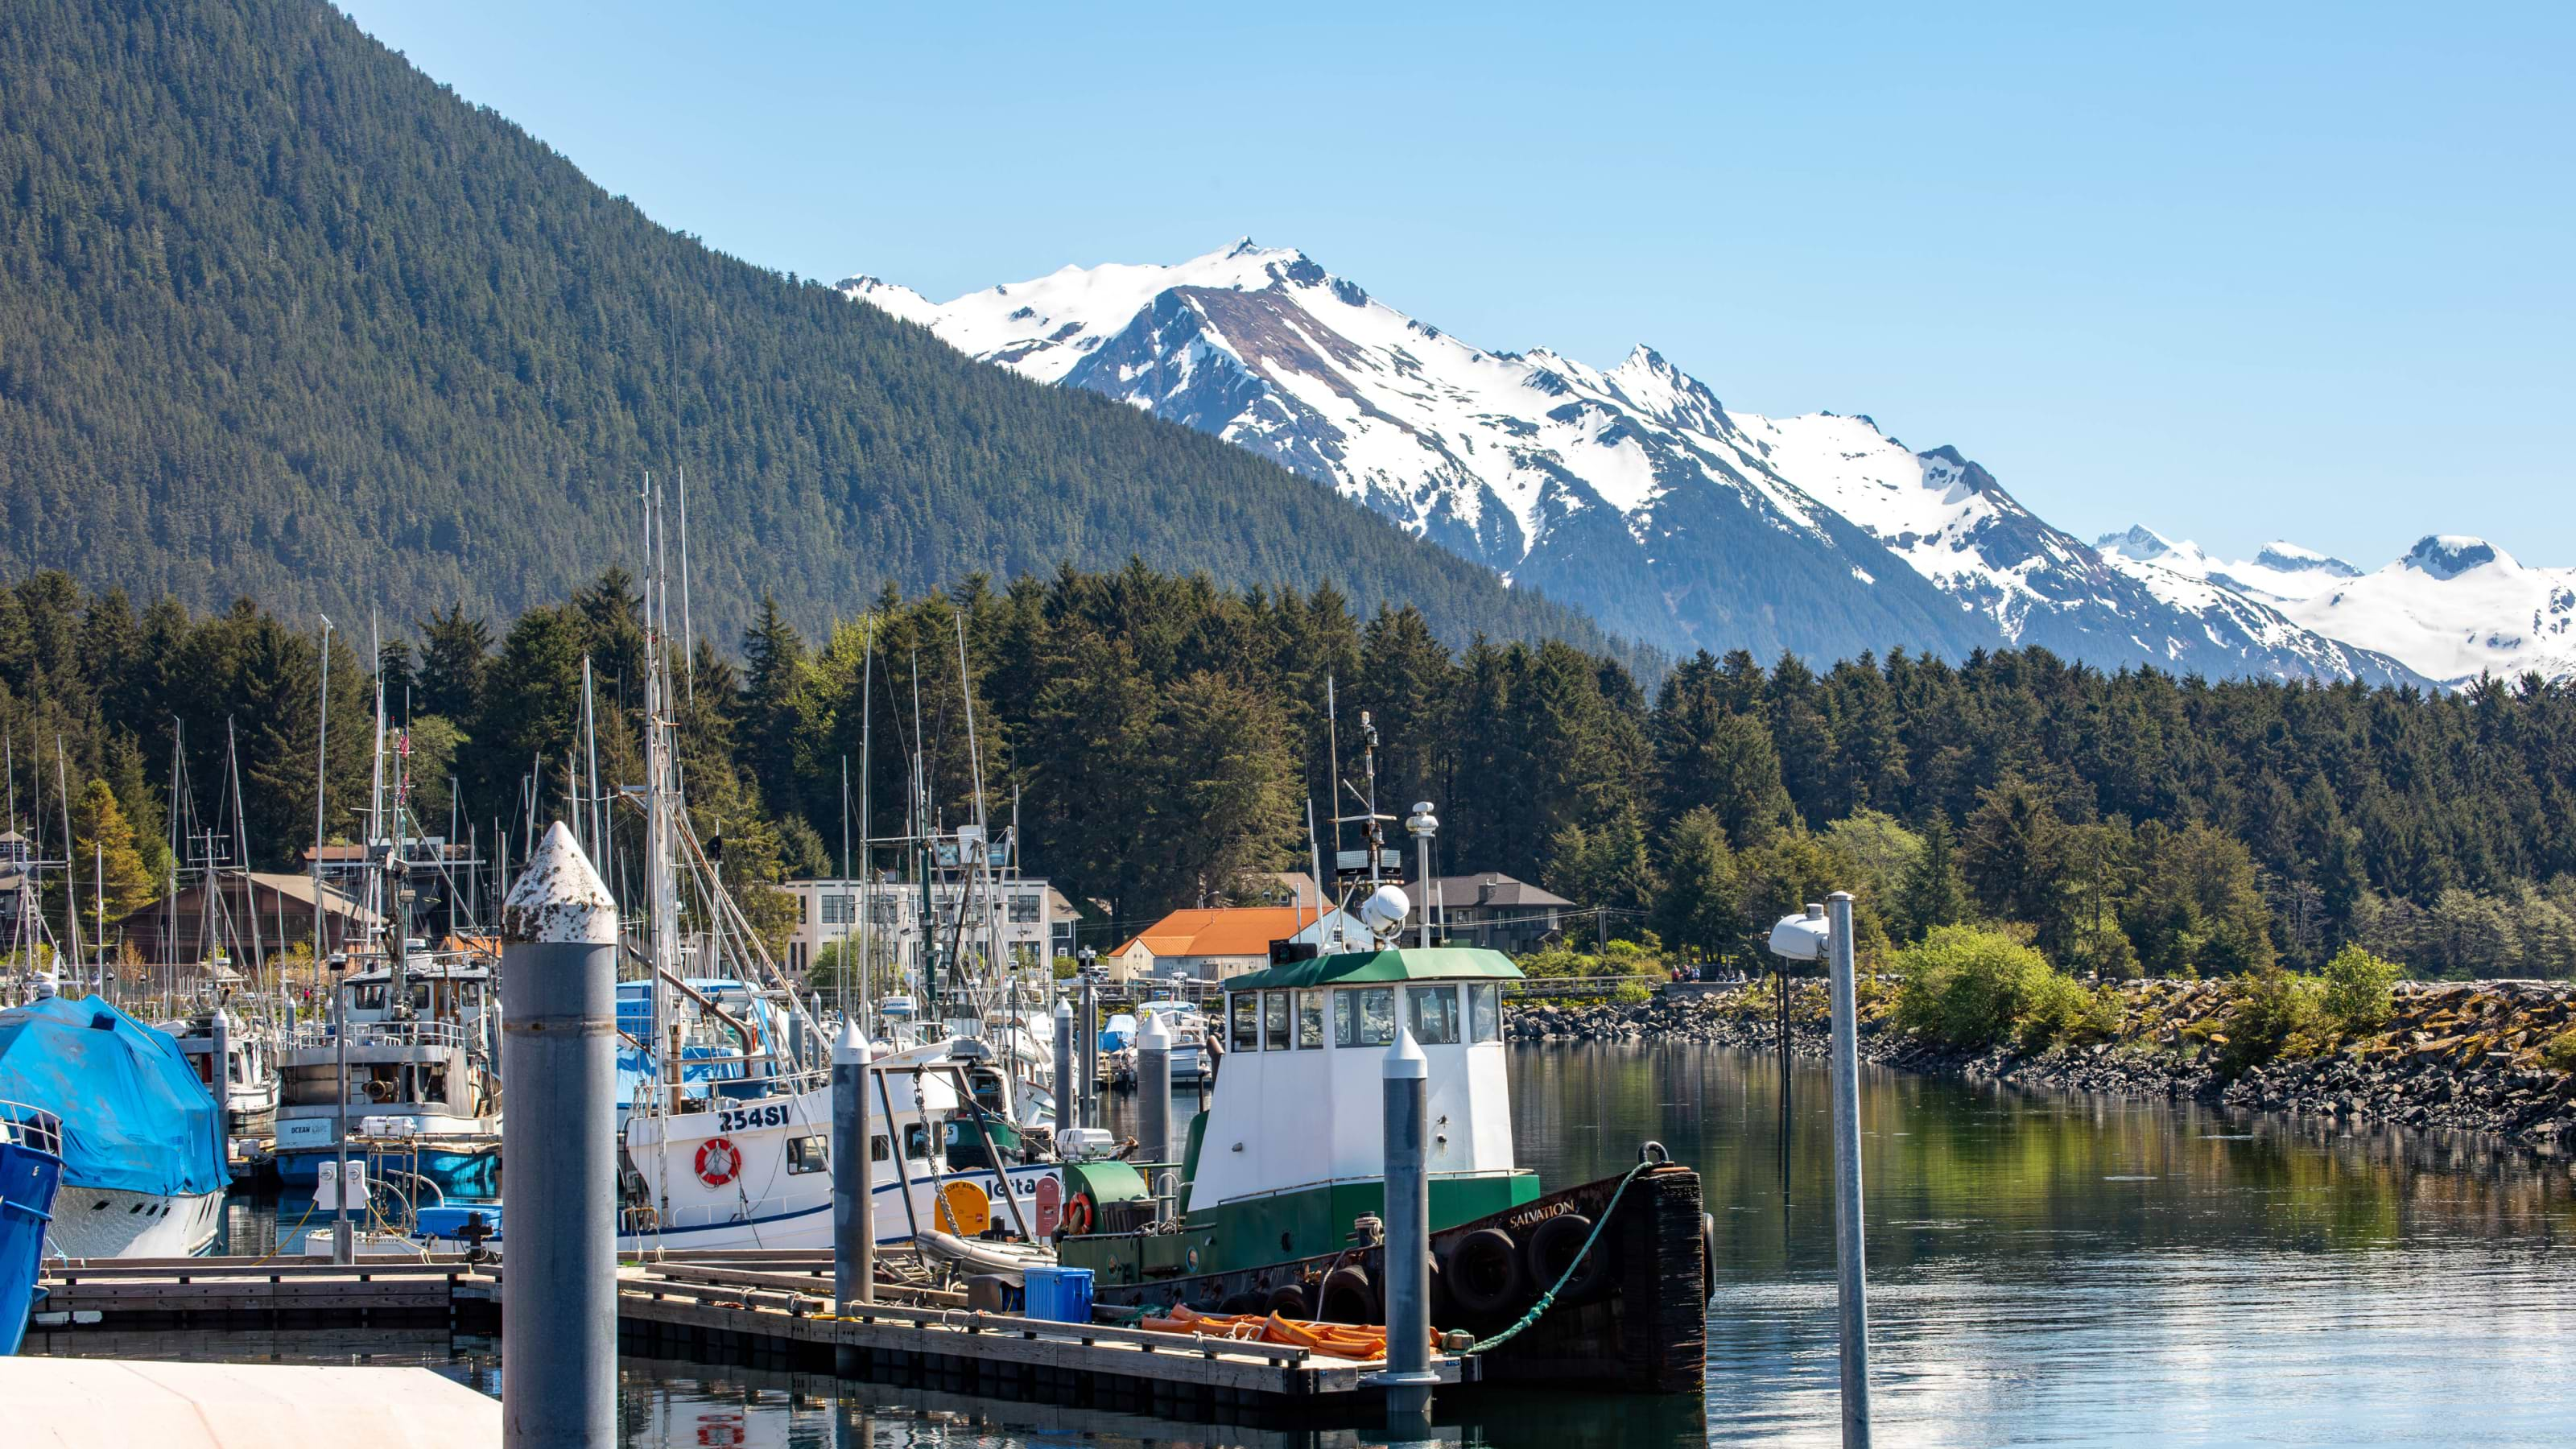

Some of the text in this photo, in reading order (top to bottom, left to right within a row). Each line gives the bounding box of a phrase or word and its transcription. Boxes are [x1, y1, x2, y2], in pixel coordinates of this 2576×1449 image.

[718, 1105, 789, 1132] 254SI
[291, 1126, 310, 1134] OCEAN
[947, 1183, 976, 1191] LIFE RING
[1509, 1199, 1575, 1228] SALVATION
